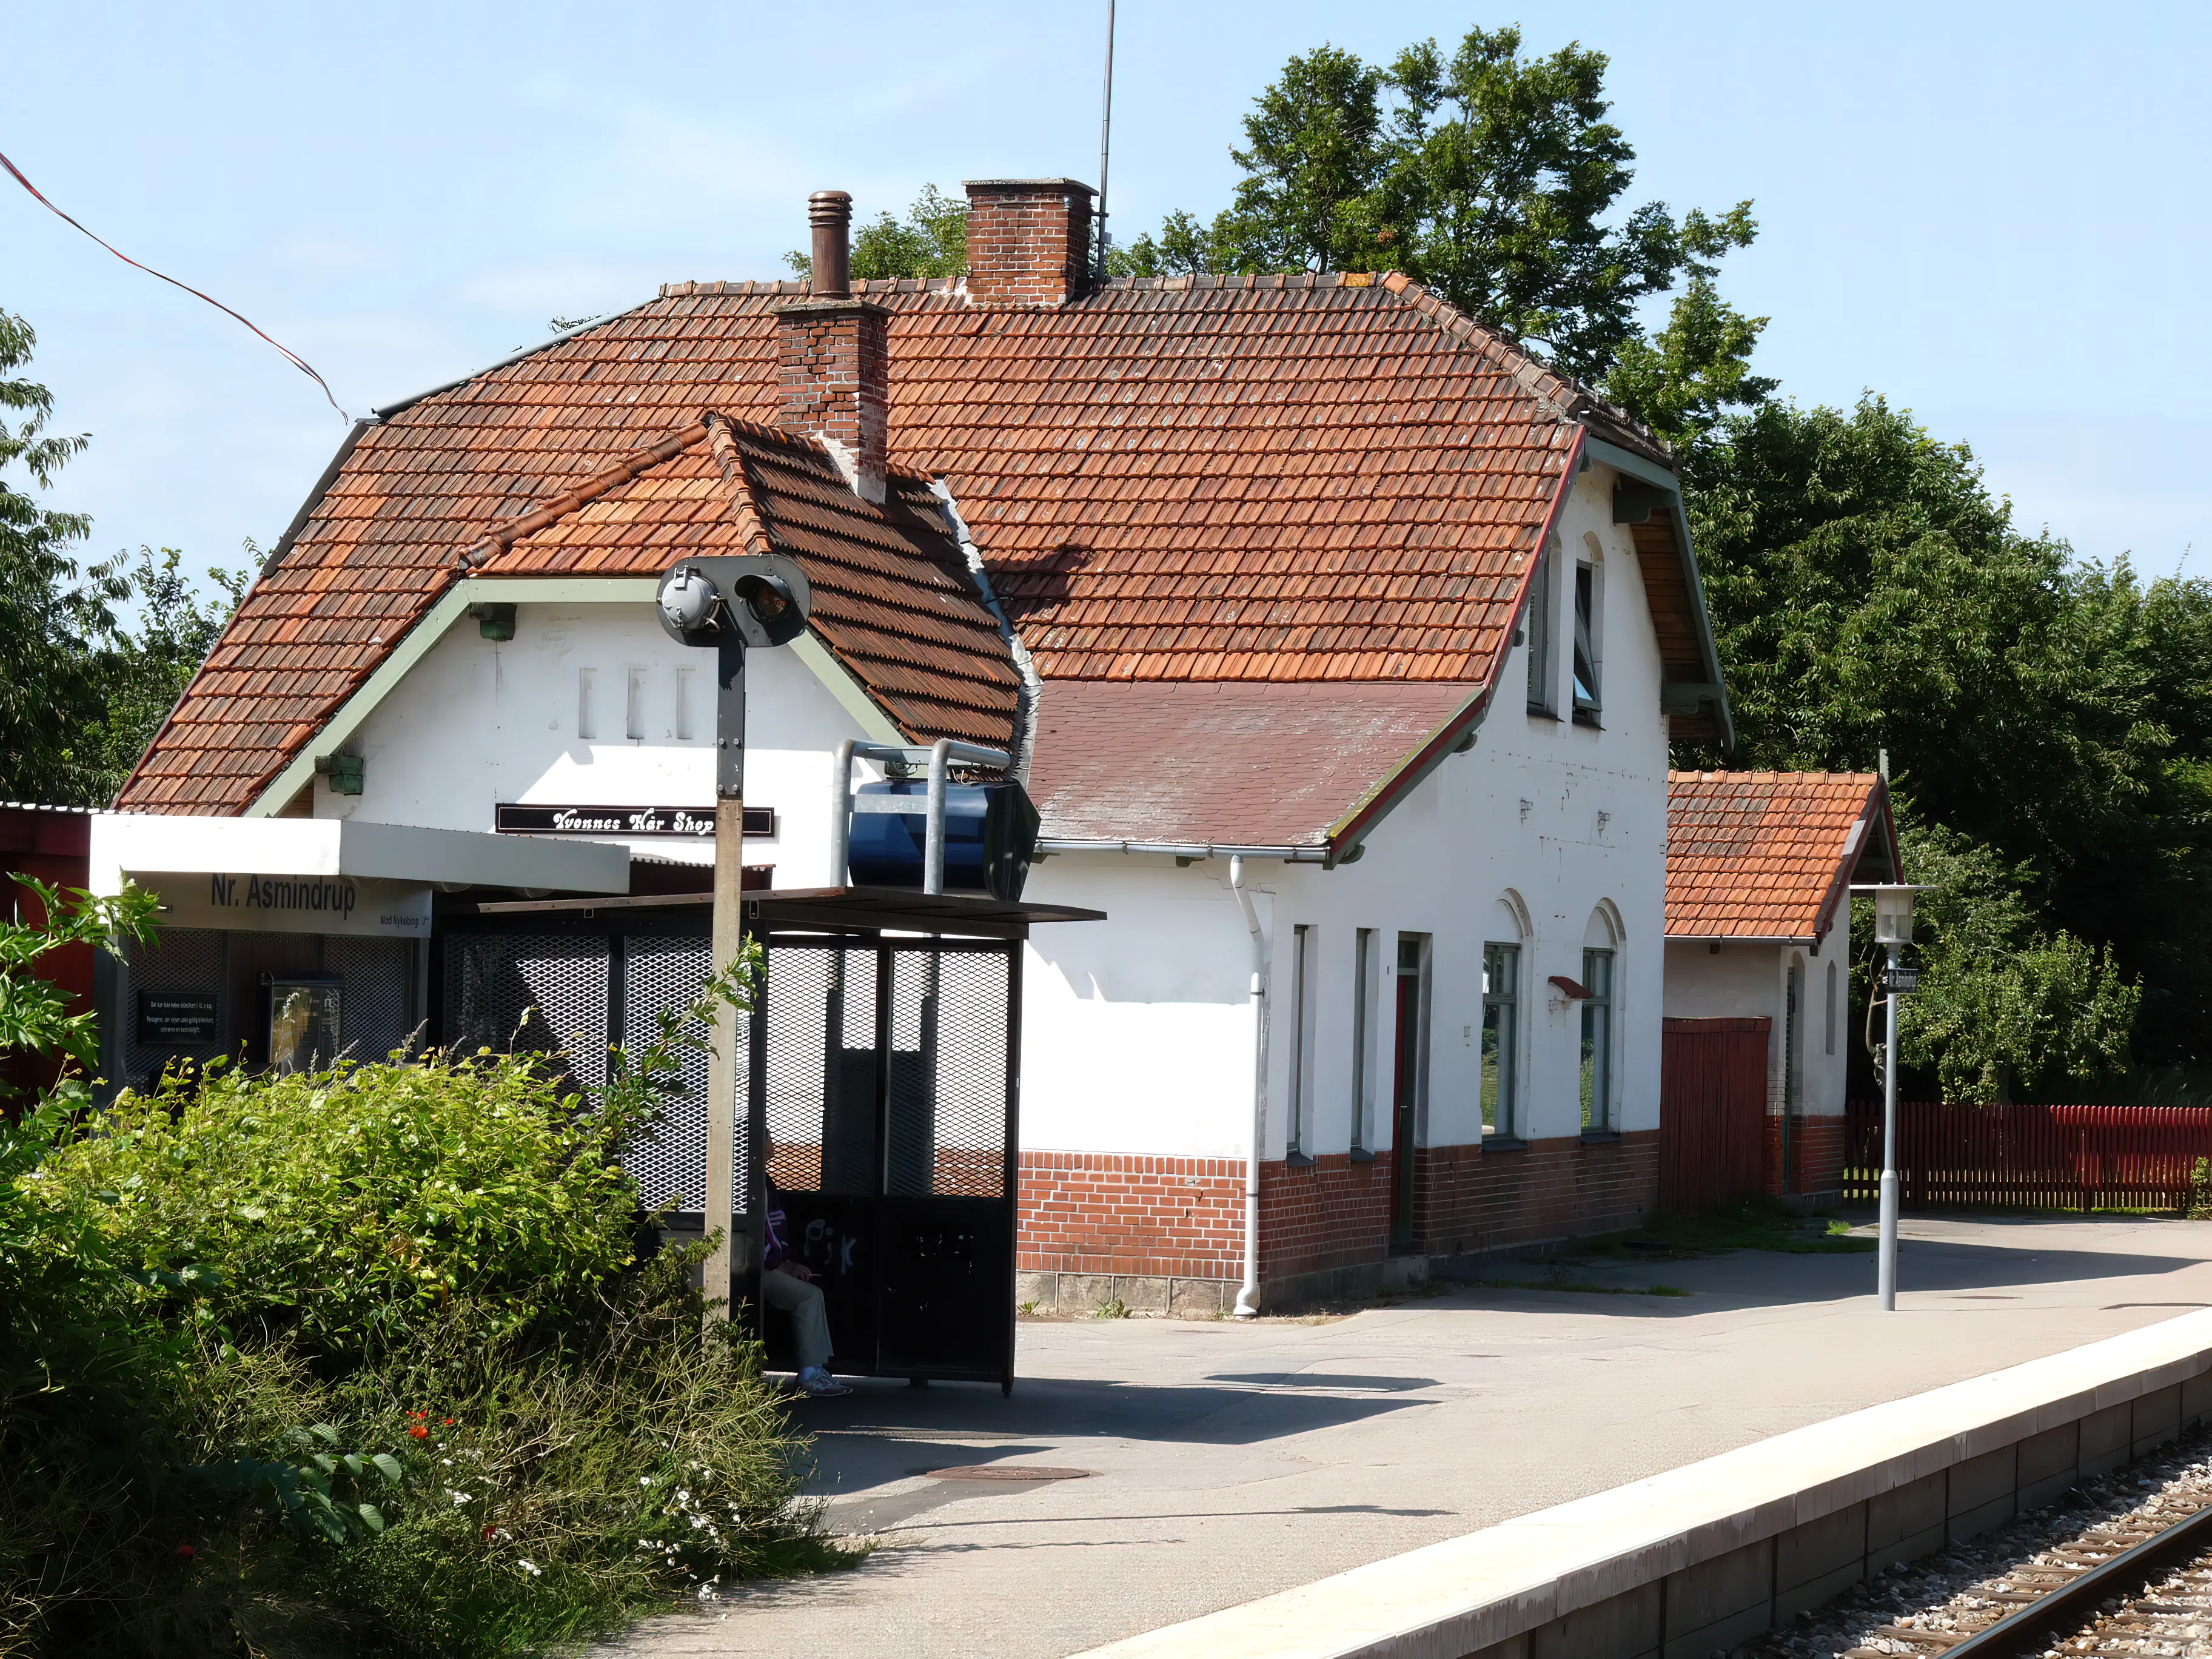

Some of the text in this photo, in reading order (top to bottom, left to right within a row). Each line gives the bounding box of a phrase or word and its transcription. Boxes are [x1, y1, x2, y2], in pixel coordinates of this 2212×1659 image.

[553, 807, 714, 836] Yvonnes Hår Shop
[212, 873, 355, 920] Nr. Asmindrup
[380, 914, 392, 925] Mod
